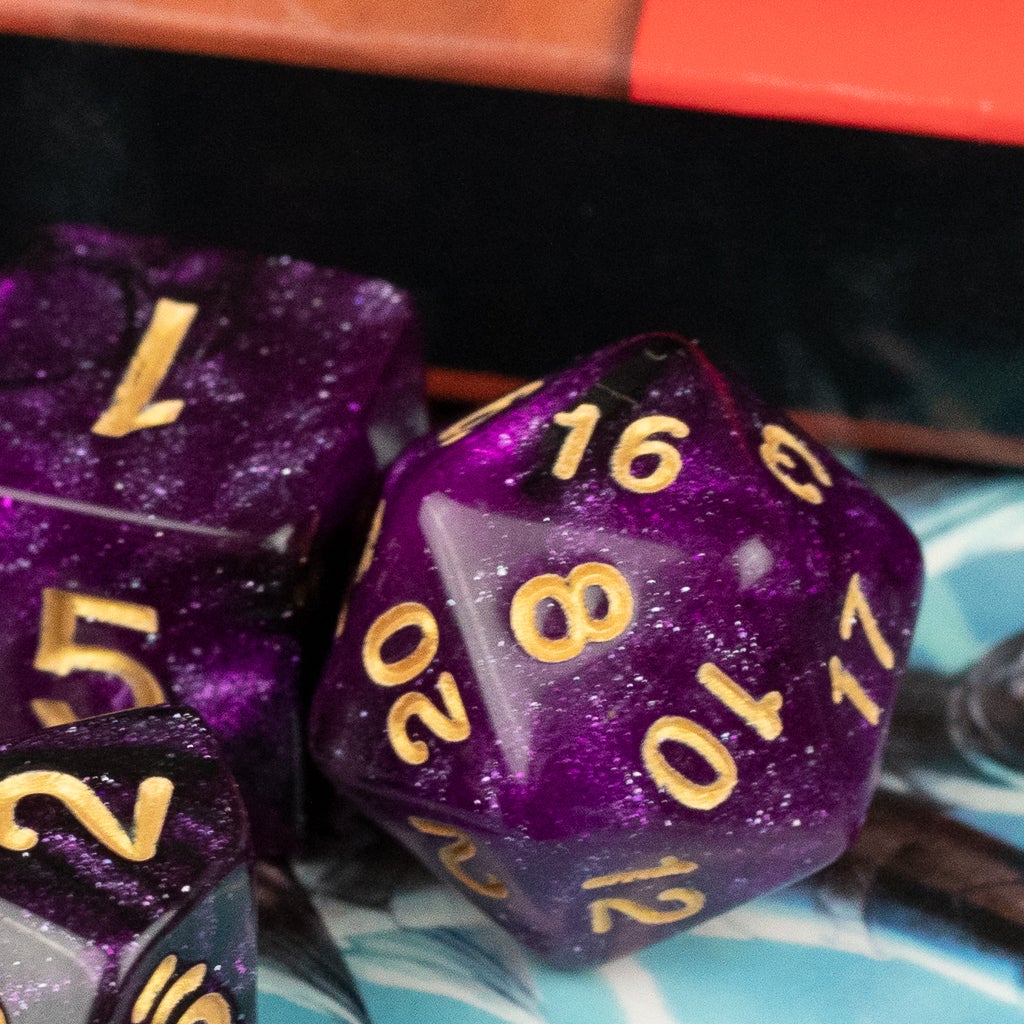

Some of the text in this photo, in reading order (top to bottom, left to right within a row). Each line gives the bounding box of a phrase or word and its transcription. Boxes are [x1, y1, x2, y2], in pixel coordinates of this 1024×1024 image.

[94, 299, 199, 438] 1
[554, 404, 690, 494] 16
[761, 426, 832, 504] 3
[33, 591, 165, 728] 5
[511, 564, 634, 663] 8
[830, 577, 895, 725] 17
[364, 603, 470, 766] 20
[644, 665, 784, 811] 10
[581, 855, 705, 934] 12
